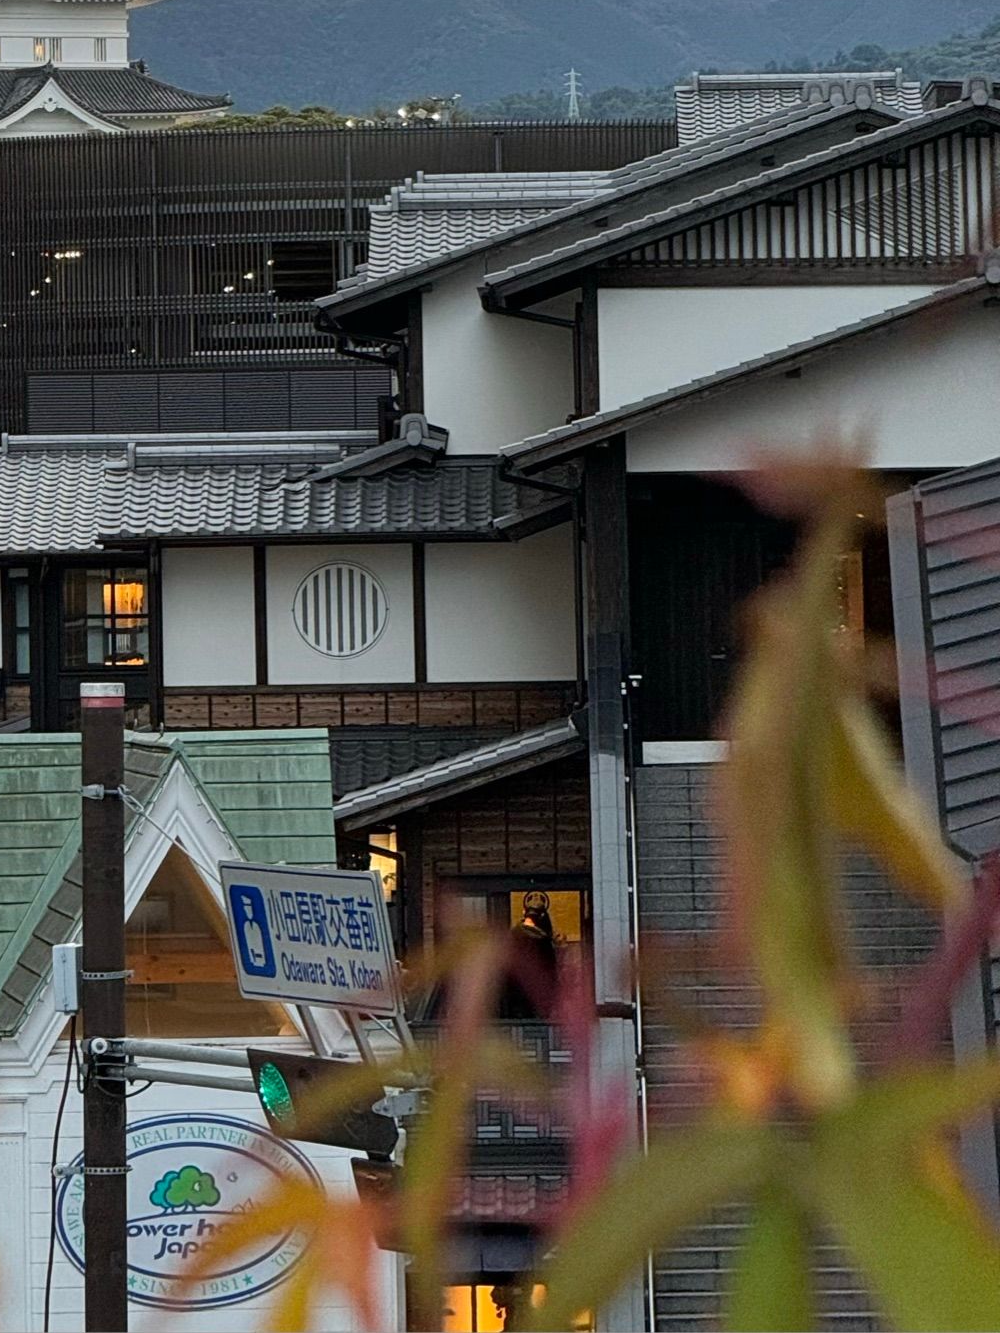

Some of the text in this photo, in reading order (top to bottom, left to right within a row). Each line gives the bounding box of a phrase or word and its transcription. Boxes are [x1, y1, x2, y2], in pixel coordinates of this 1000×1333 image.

[268, 889, 380, 953] 小田原駅交番前
[281, 952, 327, 986] Odawara
[349, 958, 384, 991] Koban
[132, 1128, 173, 1149] REAL
[176, 1126, 248, 1148] PARTNER
[127, 1224, 193, 1238] ower
[201, 1277, 240, 1296] 1981
